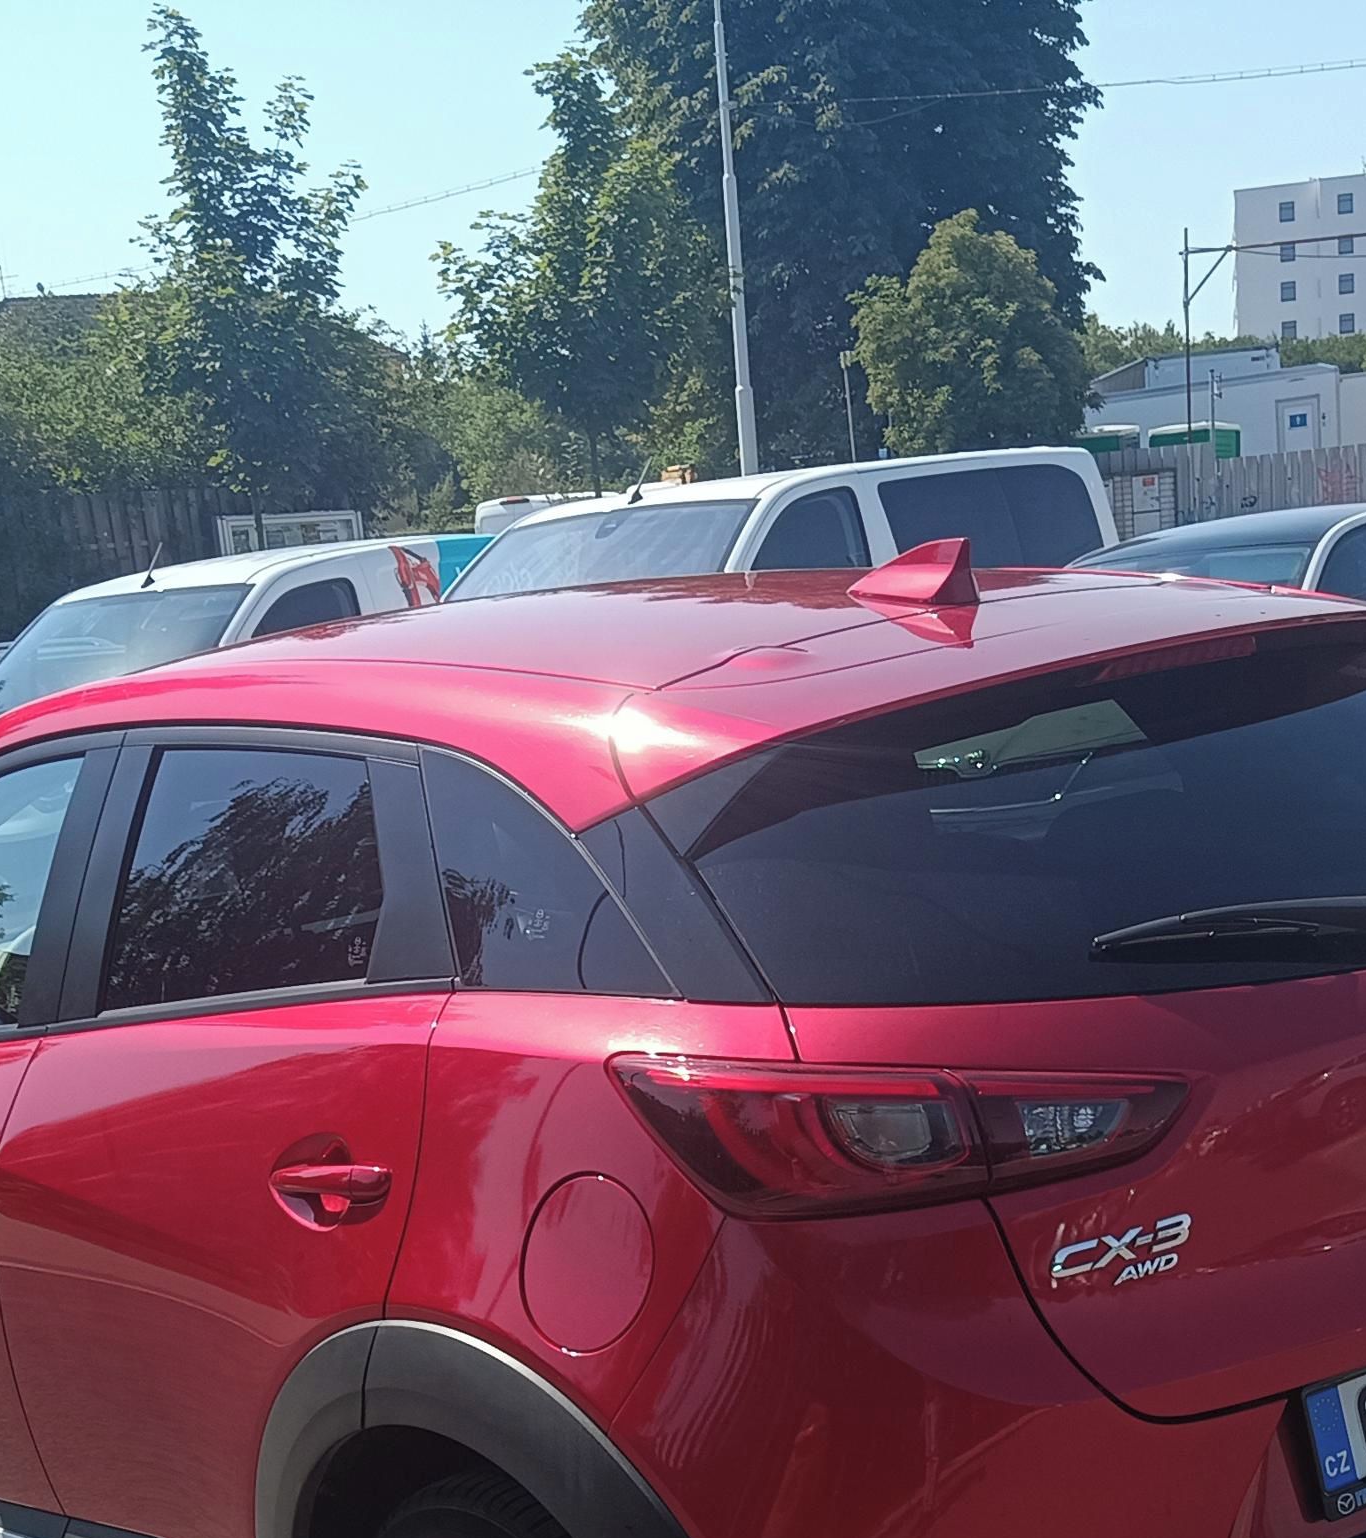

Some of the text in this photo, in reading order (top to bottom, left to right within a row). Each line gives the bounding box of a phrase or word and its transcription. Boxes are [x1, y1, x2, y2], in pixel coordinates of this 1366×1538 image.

[1051, 1213, 1193, 1279] CX-3
[1113, 1253, 1179, 1287] AWD
[1324, 1450, 1351, 1477] CZ
